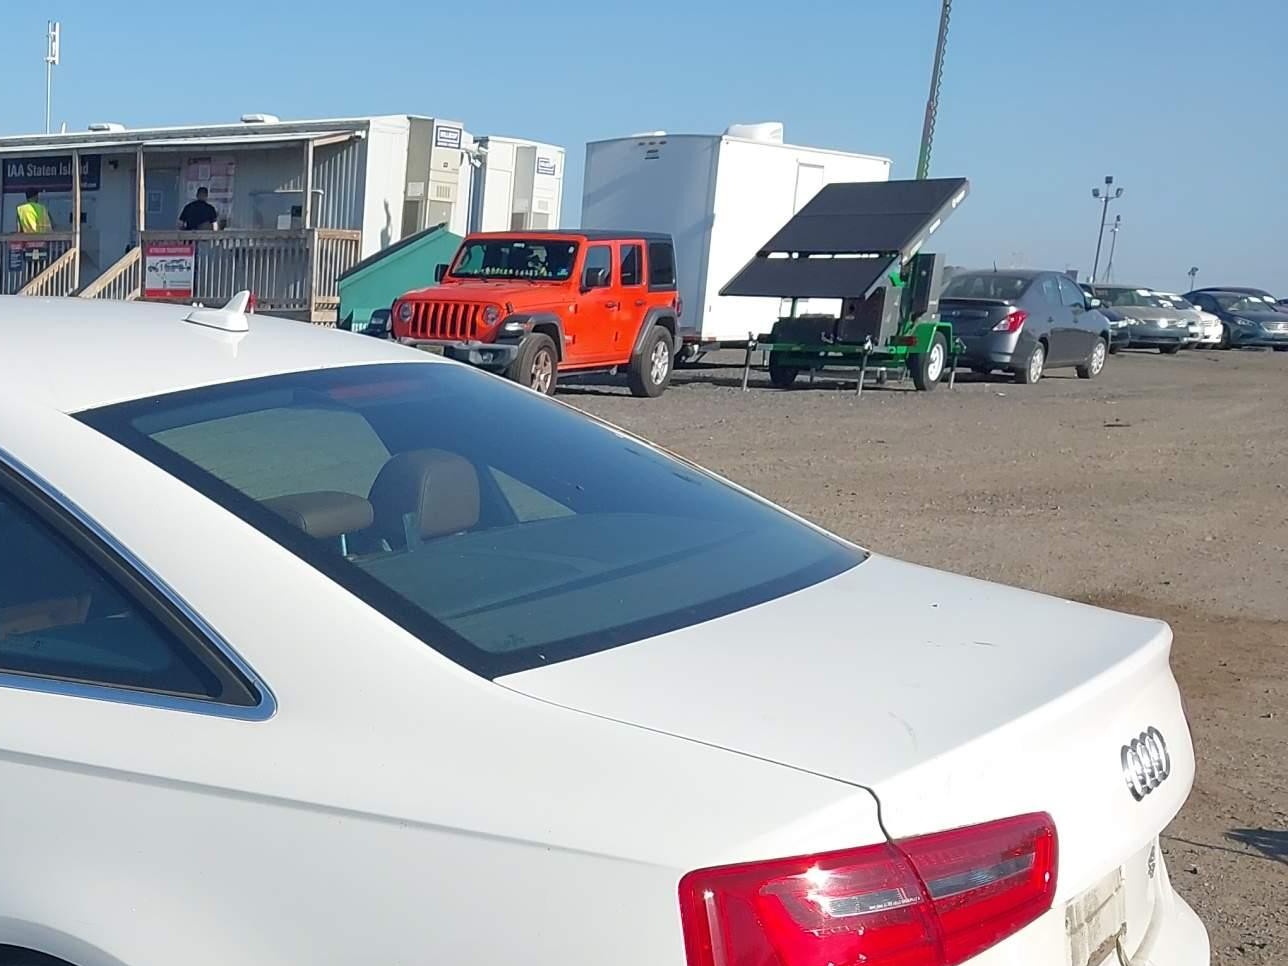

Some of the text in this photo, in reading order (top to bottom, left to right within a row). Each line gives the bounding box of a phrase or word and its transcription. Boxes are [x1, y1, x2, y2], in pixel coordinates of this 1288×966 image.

[7, 161, 89, 178] IAA Staten Isld
